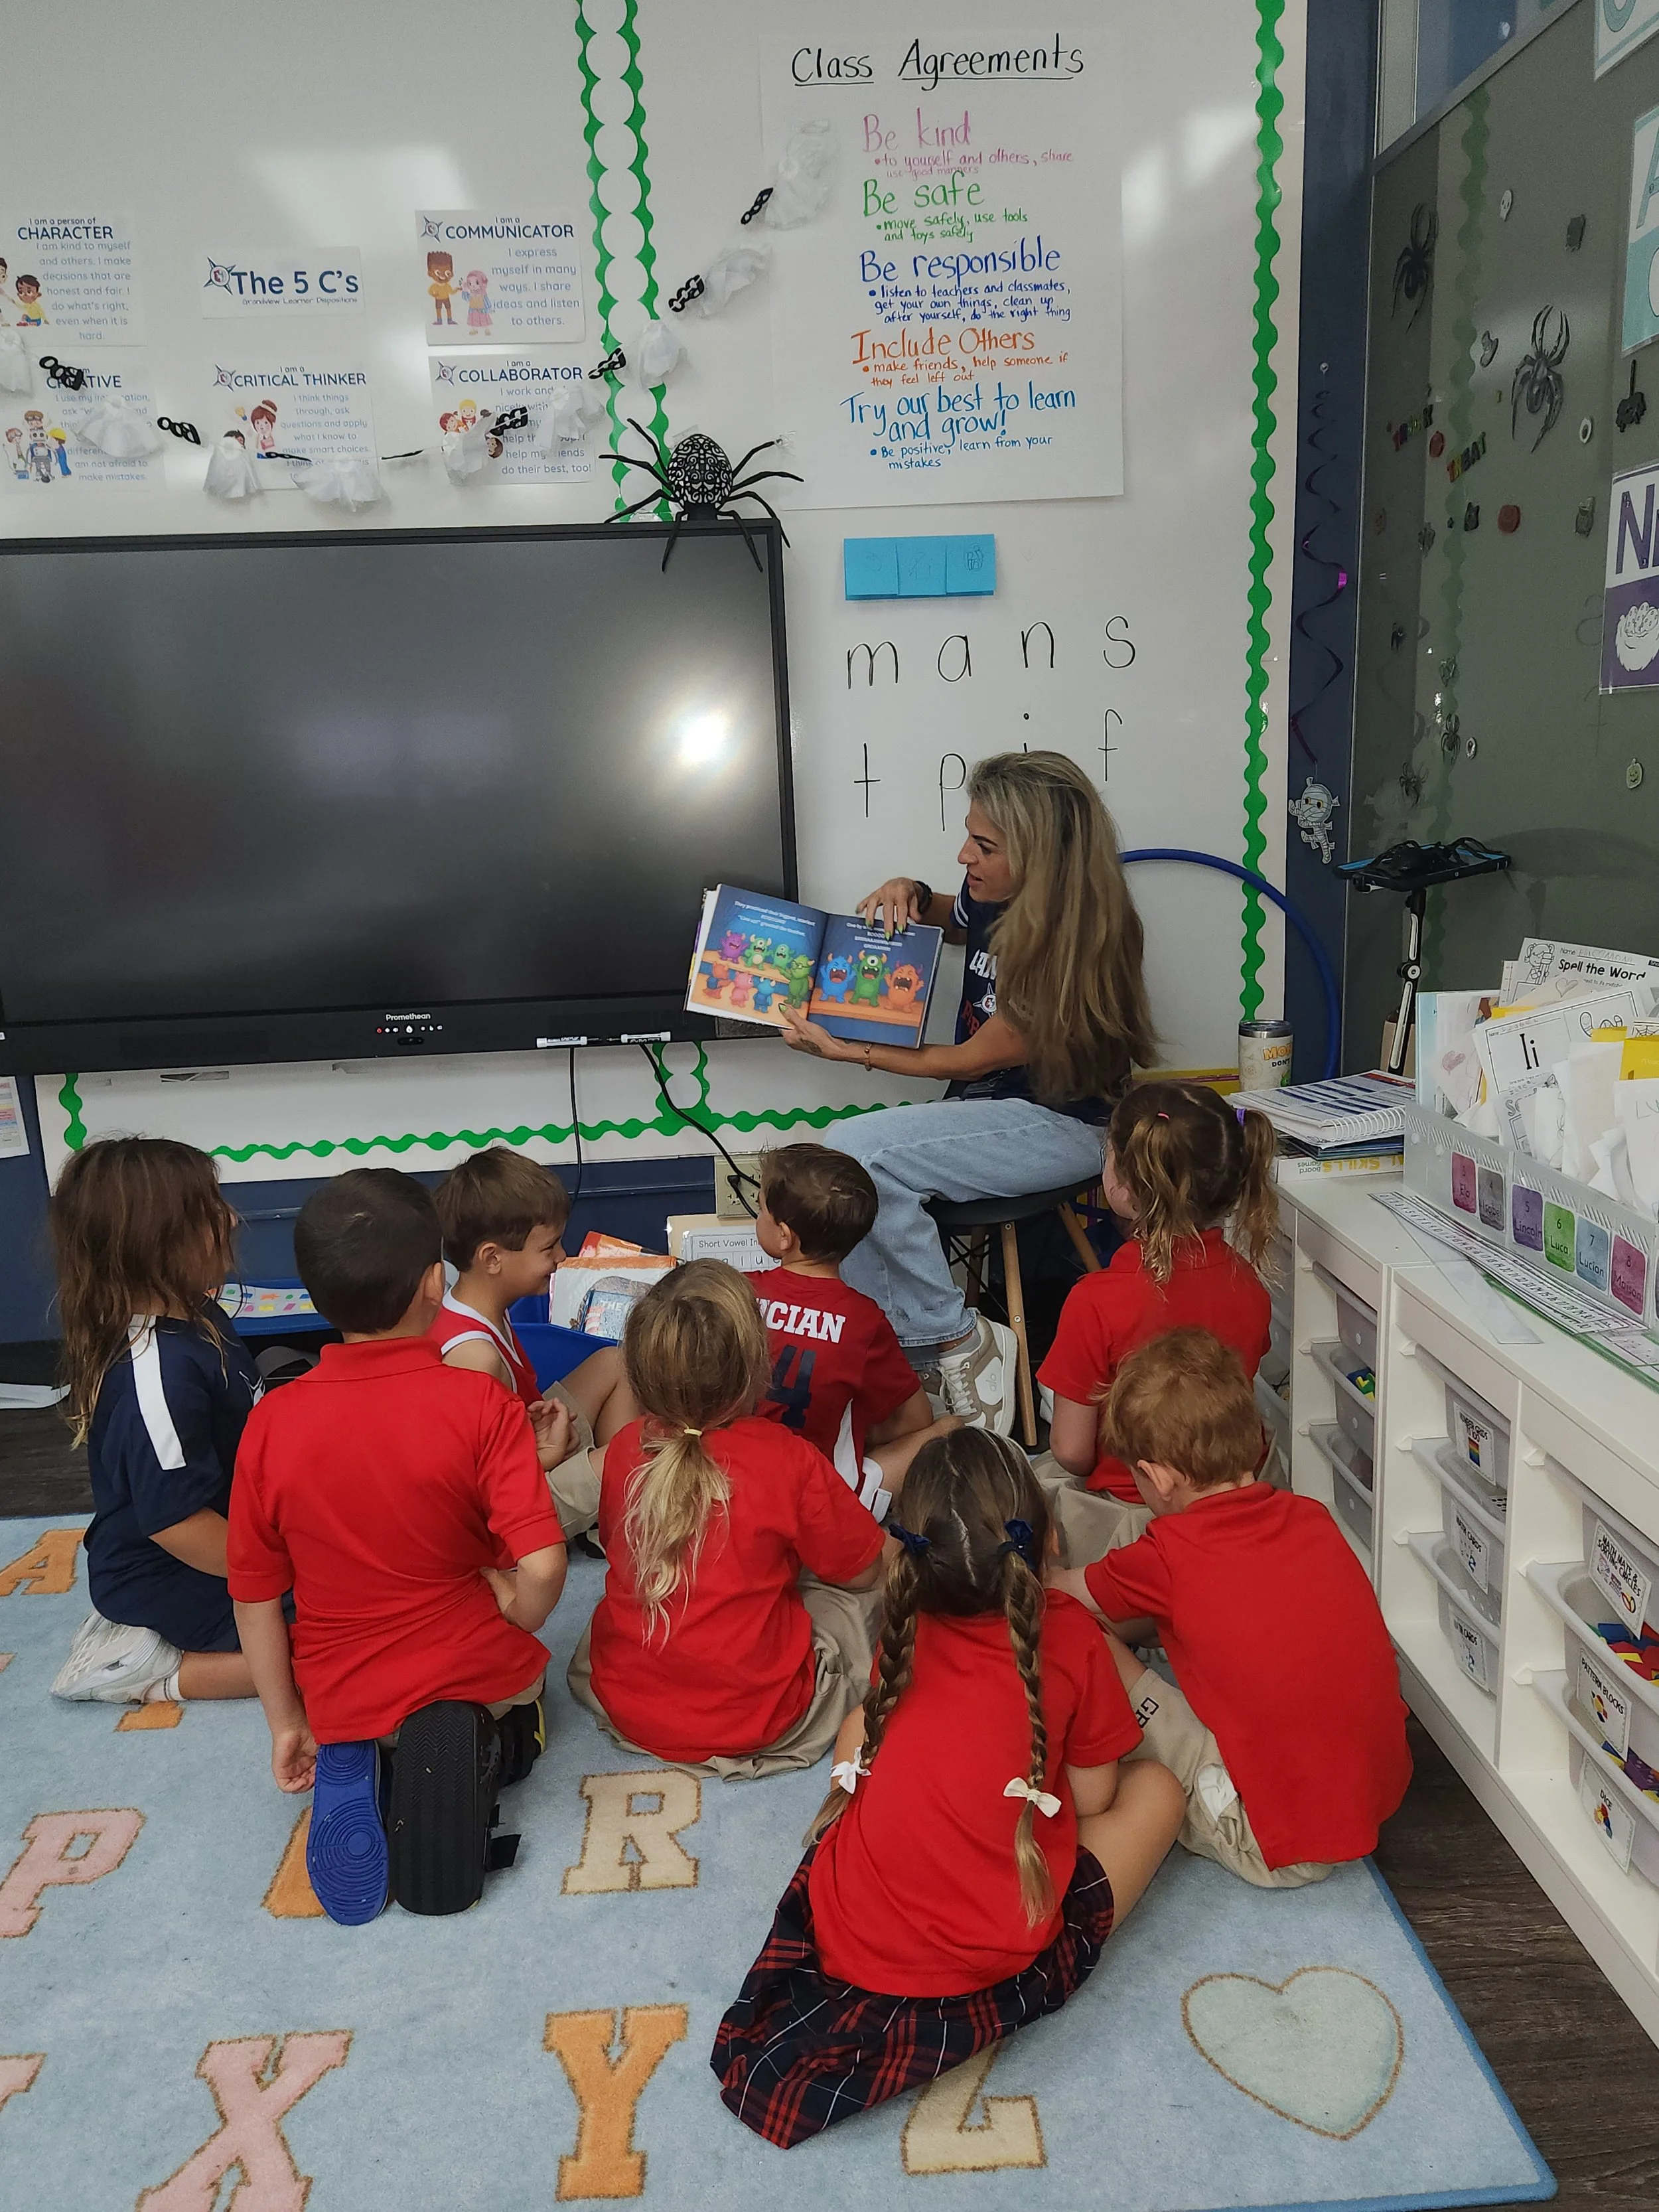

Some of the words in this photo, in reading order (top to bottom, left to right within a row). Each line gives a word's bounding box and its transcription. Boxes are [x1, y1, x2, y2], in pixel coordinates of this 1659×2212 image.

[792, 47, 873, 82] Class
[898, 33, 1084, 91] Agreements
[863, 113, 899, 152] Be
[916, 107, 971, 148] kind
[883, 153, 897, 166] to
[960, 151, 982, 165] and
[989, 147, 1037, 167] others,
[1041, 149, 1073, 163] share
[863, 179, 899, 217] Be
[914, 170, 984, 208] safe
[885, 219, 916, 231] move
[924, 212, 970, 230] safely,
[974, 213, 995, 223] use
[1003, 207, 1028, 222] tools
[17, 226, 113, 240] CHARACTER
[446, 225, 573, 239] COMMUNICATOR
[885, 230, 903, 242] and
[911, 230, 935, 244] toys
[940, 226, 974, 243] safely
[61, 242, 81, 250] kind
[98, 241, 131, 252] myself
[515, 249, 557, 258] express
[492, 265, 528, 277] myself
[546, 266, 576, 275] many
[860, 250, 899, 282] Be
[913, 235, 1060, 287] responsible
[231, 271, 283, 295] The
[294, 271, 309, 294] 5
[319, 271, 358, 293] C's
[541, 281, 571, 291] share
[881, 285, 912, 298] listen
[915, 287, 926, 297] to
[932, 285, 979, 298] teachers
[984, 280, 1003, 293] and
[1008, 279, 1071, 295] classmates,
[494, 300, 522, 309] ideas
[526, 299, 546, 309] and
[551, 299, 580, 307] listen
[875, 299, 893, 315] get
[901, 301, 924, 313] your
[930, 299, 951, 309] own
[959, 297, 998, 314] things,
[1003, 296, 1032, 306] clean
[1041, 297, 1054, 309] up
[526, 316, 565, 325] others.
[885, 313, 912, 323] after
[919, 310, 965, 323] yourself,
[970, 311, 981, 321] do
[989, 309, 1005, 319] the
[1011, 307, 1039, 322] right
[1046, 306, 1071, 322] thing
[851, 327, 951, 364] Include
[959, 327, 1035, 354] Others
[874, 361, 908, 372] make
[914, 357, 966, 373] friends,
[973, 356, 996, 370] help
[1004, 355, 1053, 366] someone
[1059, 352, 1068, 363] if
[234, 374, 299, 387] CRITICAL
[303, 373, 366, 385] THINKER
[459, 367, 583, 382] COLLABORATOR
[871, 377, 893, 388] they
[902, 374, 918, 384] feel
[928, 373, 945, 384] left
[954, 371, 974, 382] out
[839, 392, 887, 437] Try
[897, 393, 930, 416] our
[937, 383, 983, 413] best
[993, 382, 1019, 410] to
[1029, 380, 1076, 409] learn
[889, 413, 930, 442] and
[942, 409, 1007, 449] grow!
[882, 446, 895, 457] Be
[901, 443, 951, 458] positive,
[960, 437, 991, 451] learn
[995, 437, 1021, 448] from
[1026, 436, 1053, 451] your
[518, 465, 540, 474] their
[544, 465, 569, 474] best,
[572, 464, 591, 473] too!
[889, 459, 942, 469] mistakes
[847, 641, 899, 690] m
[938, 635, 972, 682] a
[1021, 621, 1054, 668] n
[1103, 615, 1136, 668] s
[854, 743, 881, 818] t
[939, 753, 966, 832] p
[1097, 709, 1123, 782] f
[1559, 959, 1583, 972] Spell
[1587, 963, 1605, 975] the
[386, 1012, 431, 1022] Promethean
[1520, 1033, 1540, 1070] Ii
[1323, 1157, 1380, 1173] SKILLS
[1526, 1201, 1530, 1213] 5
[1514, 1217, 1542, 1237] Lincoln
[1557, 1218, 1561, 1229] 6
[1551, 1235, 1568, 1254] Luca
[1590, 1234, 1595, 1246] 7
[1579, 1252, 1604, 1277] Lucian
[601, 1301, 623, 1311] THE
[756, 1298, 846, 1343] CIAN
[766, 1345, 816, 1429] 4
[986, 1372, 997, 1392] alo
[1597, 1539, 1617, 1570] SORTING
[1619, 1567, 1641, 1597] CIRCLES
[1603, 1534, 1617, 1558] MATH
[1617, 1554, 1632, 1575] MATS
[1632, 1574, 1638, 1583] &
[1581, 1657, 1603, 1692] PATTERN
[1603, 1687, 1624, 1714] BLOCKS
[1600, 1789, 1613, 1811] DICE
[560, 1769, 701, 1897] R
[0, 1807, 147, 1938] P
[134, 2028, 354, 2212] X
[541, 2002, 690, 2201] Y
